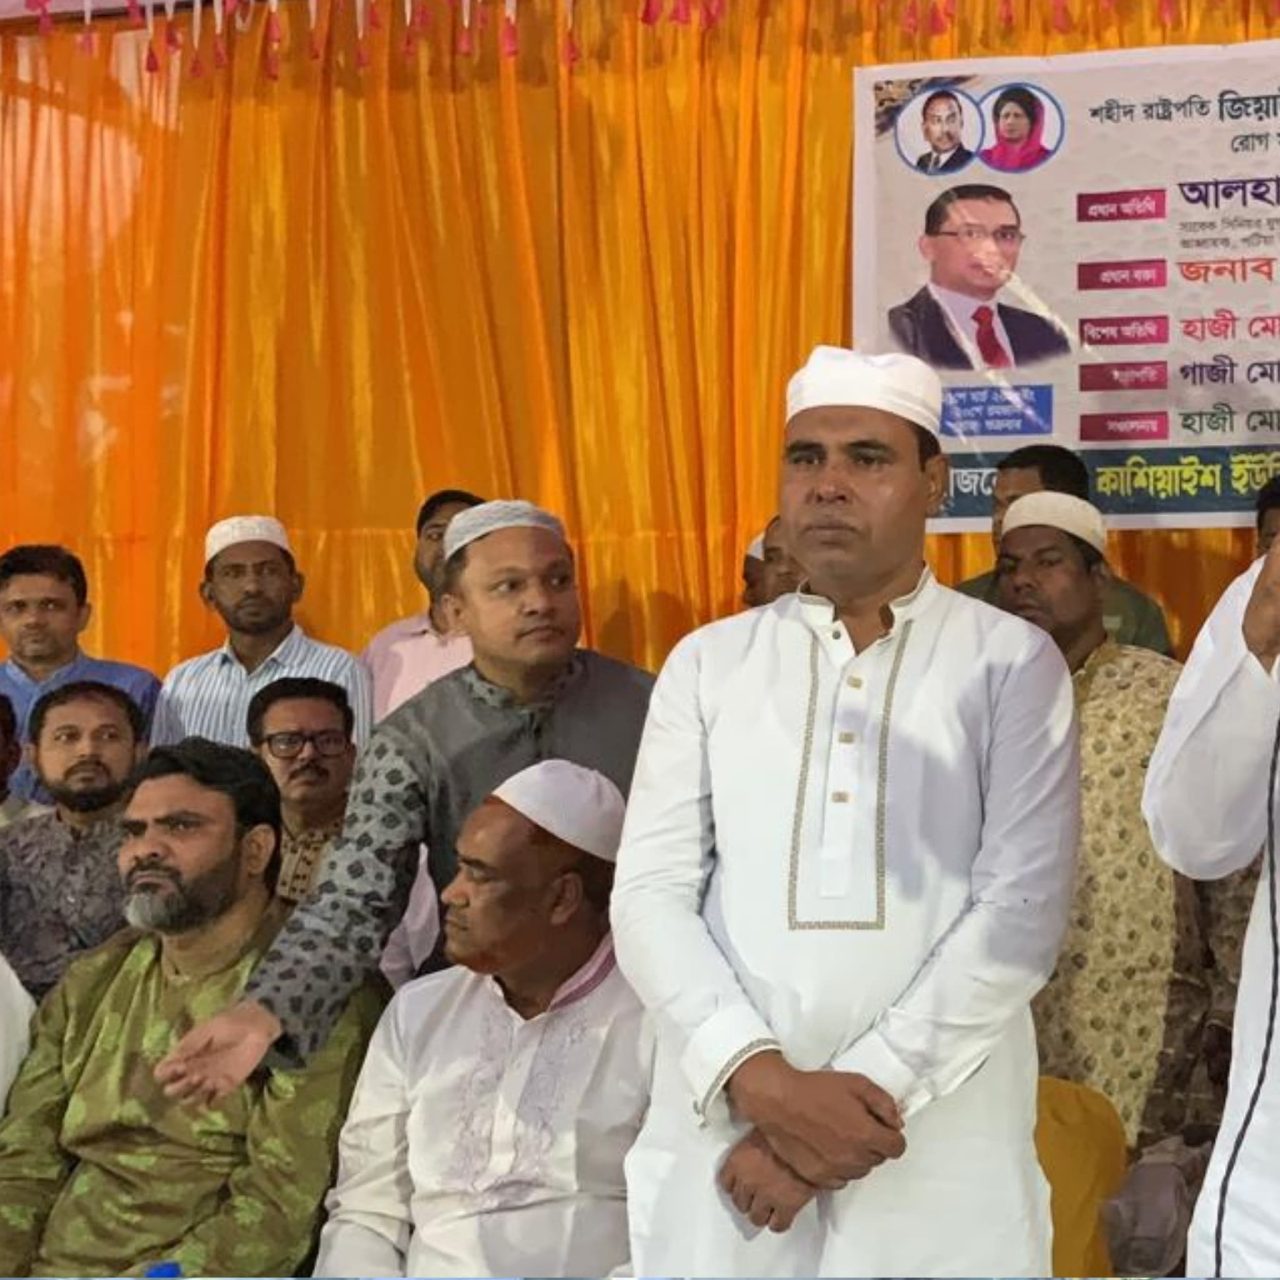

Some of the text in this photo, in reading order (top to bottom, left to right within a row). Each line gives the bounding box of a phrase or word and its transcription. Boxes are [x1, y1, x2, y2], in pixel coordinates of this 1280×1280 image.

[1089, 98, 1136, 124] শহীদ
[1143, 94, 1211, 121] রাষ্ট্রপতি
[1231, 132, 1270, 153] রোগ
[1176, 256, 1277, 284] জনাব
[1179, 309, 1240, 342] হাজী
[1179, 354, 1238, 385] গাজী
[1178, 403, 1237, 433] হাজী
[1096, 454, 1223, 499] কাশিয়াইশ
